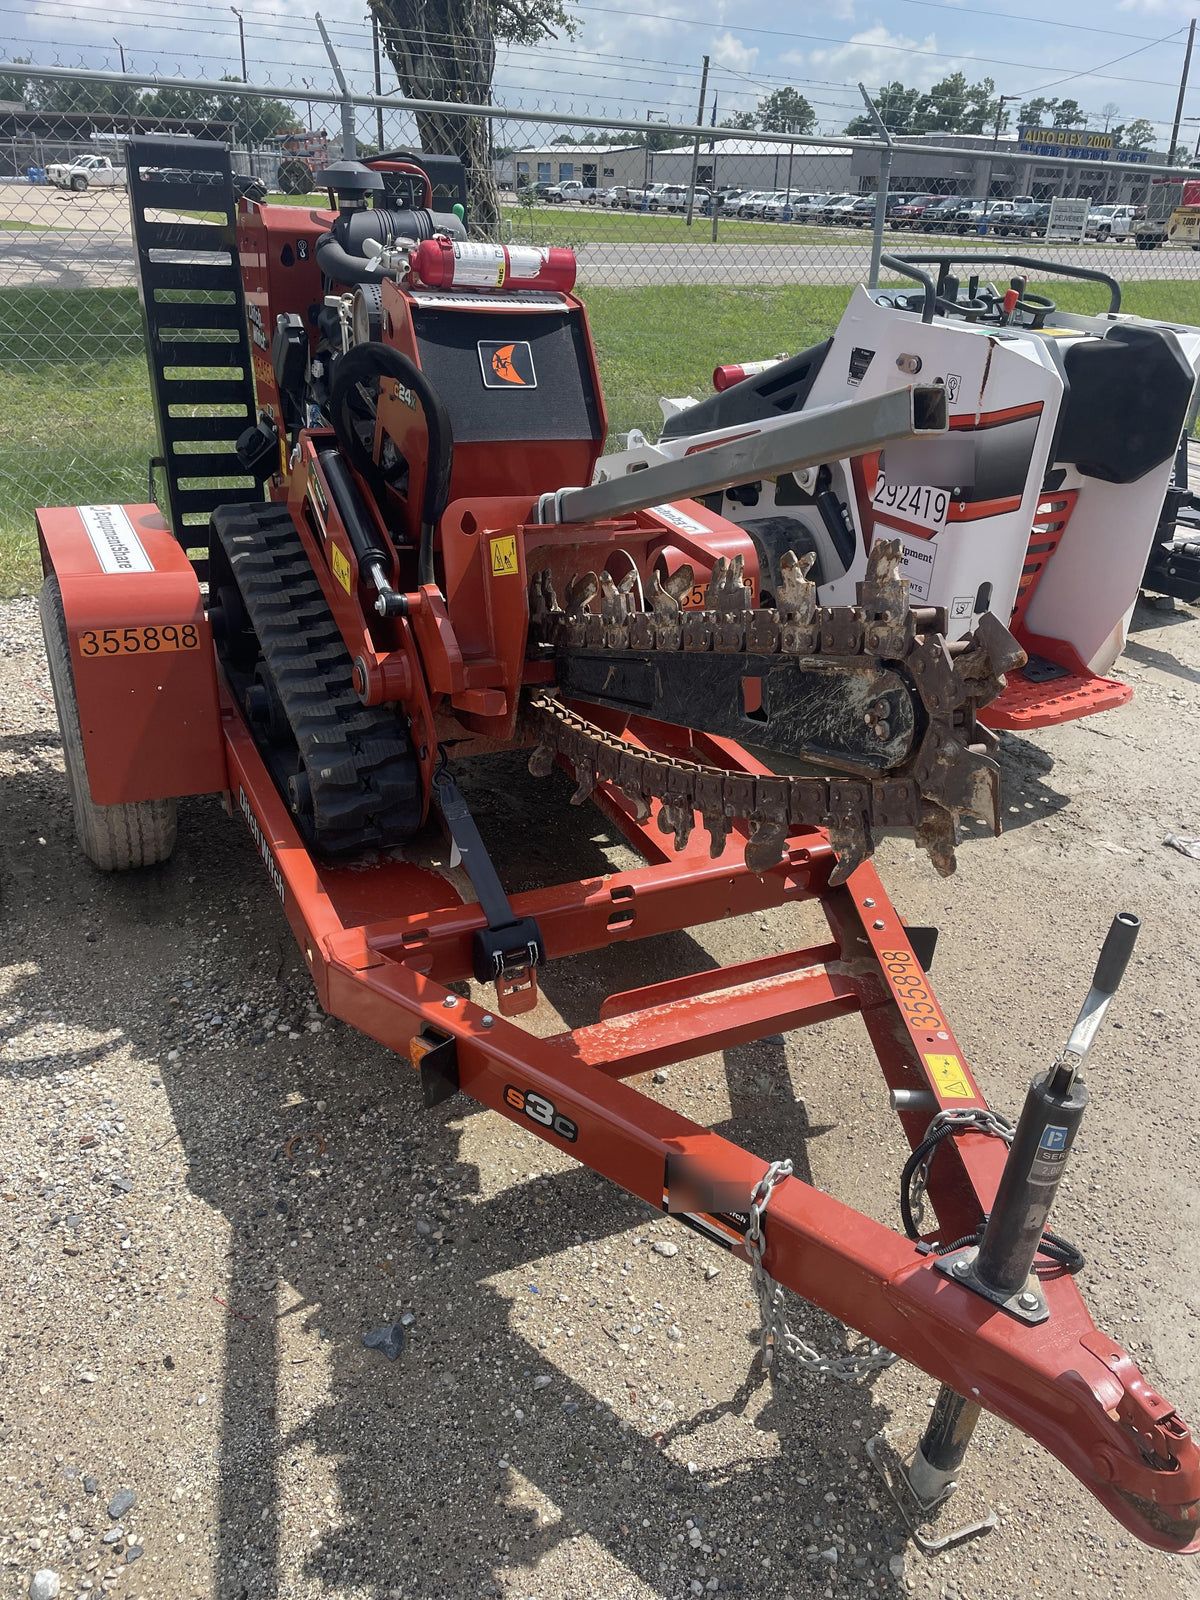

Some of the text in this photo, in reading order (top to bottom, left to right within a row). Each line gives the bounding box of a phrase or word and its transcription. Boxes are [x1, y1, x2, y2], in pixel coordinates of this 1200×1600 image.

[1024, 130, 1113, 149] AUTO PLEX 2000
[873, 473, 947, 524] 292419
[93, 511, 133, 569] EquipmentShare
[82, 623, 199, 656] 355898
[238, 784, 260, 846] Ditch
[259, 831, 286, 906] Witch
[881, 951, 942, 1029] 355898
